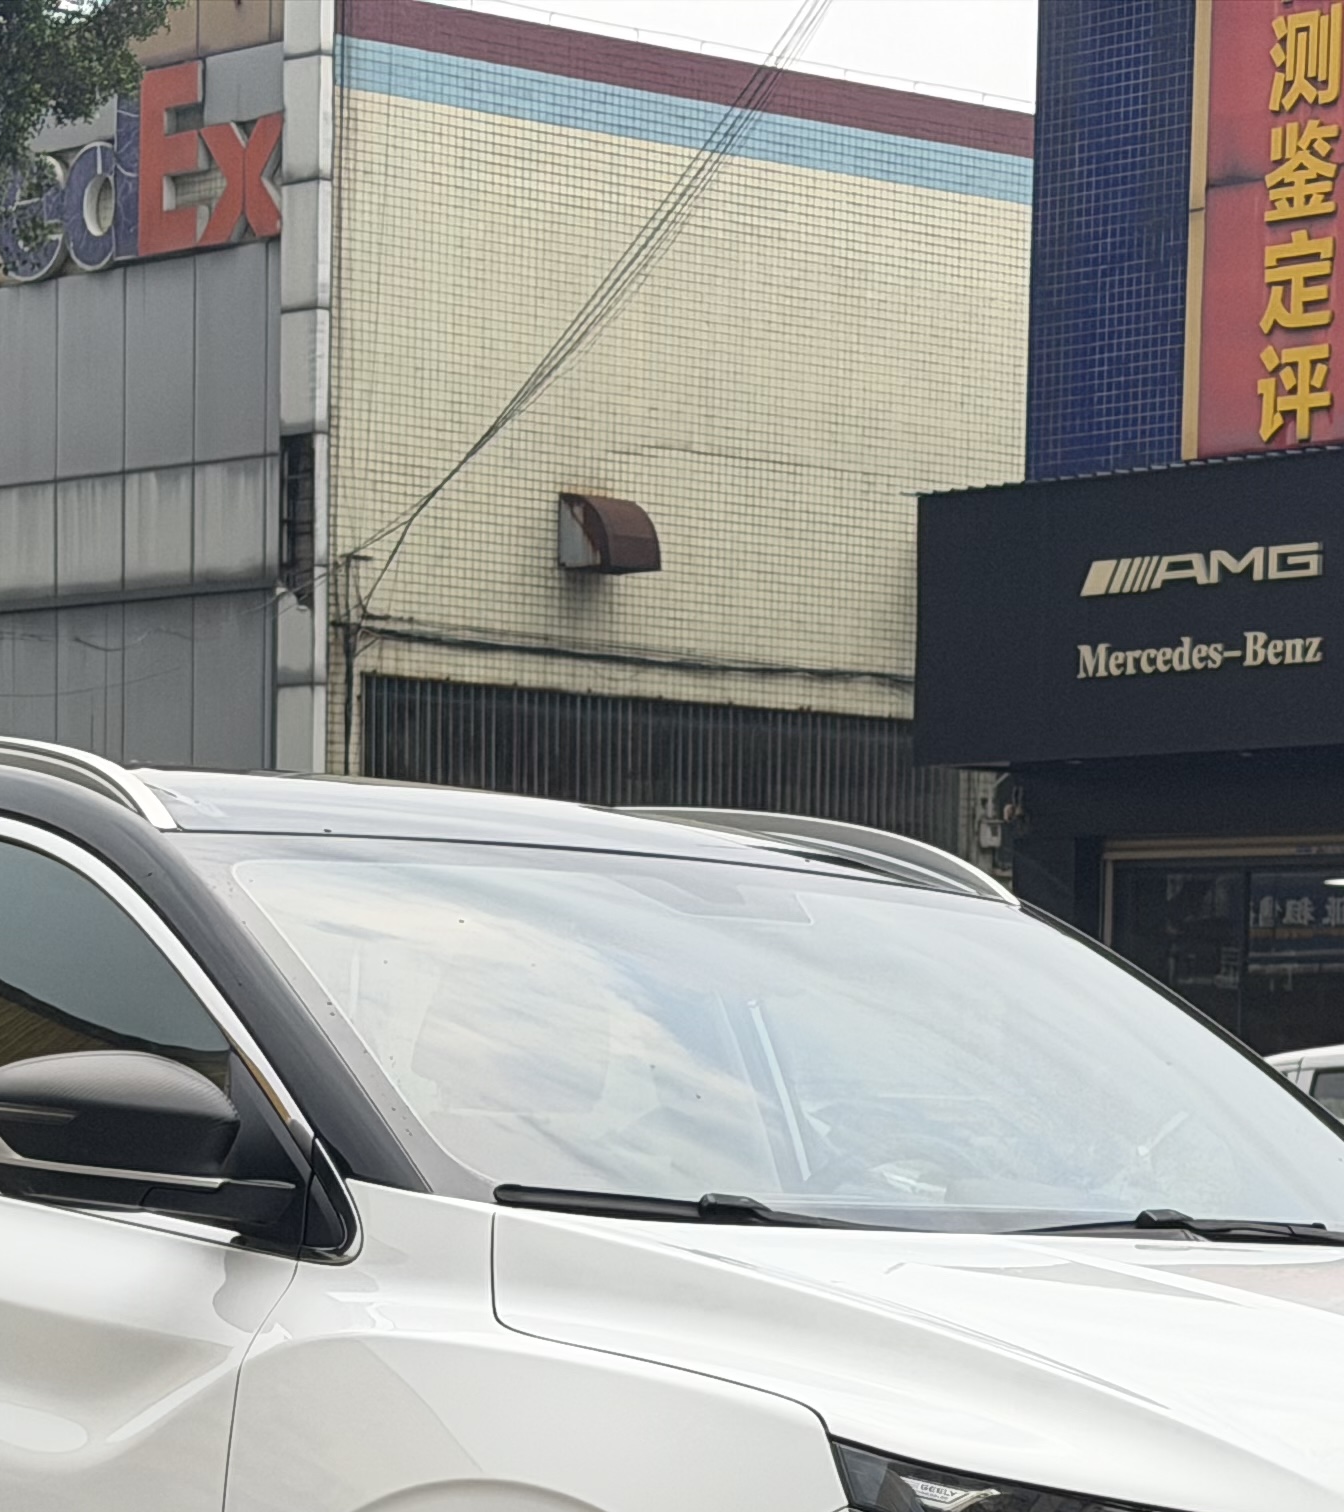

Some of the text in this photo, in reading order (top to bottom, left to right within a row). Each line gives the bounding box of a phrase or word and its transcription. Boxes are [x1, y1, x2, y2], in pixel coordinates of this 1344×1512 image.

[1150, 541, 1323, 590] AMG
[1076, 631, 1324, 680] Mercedes-Benz
[920, 1483, 957, 1497] GEELY
